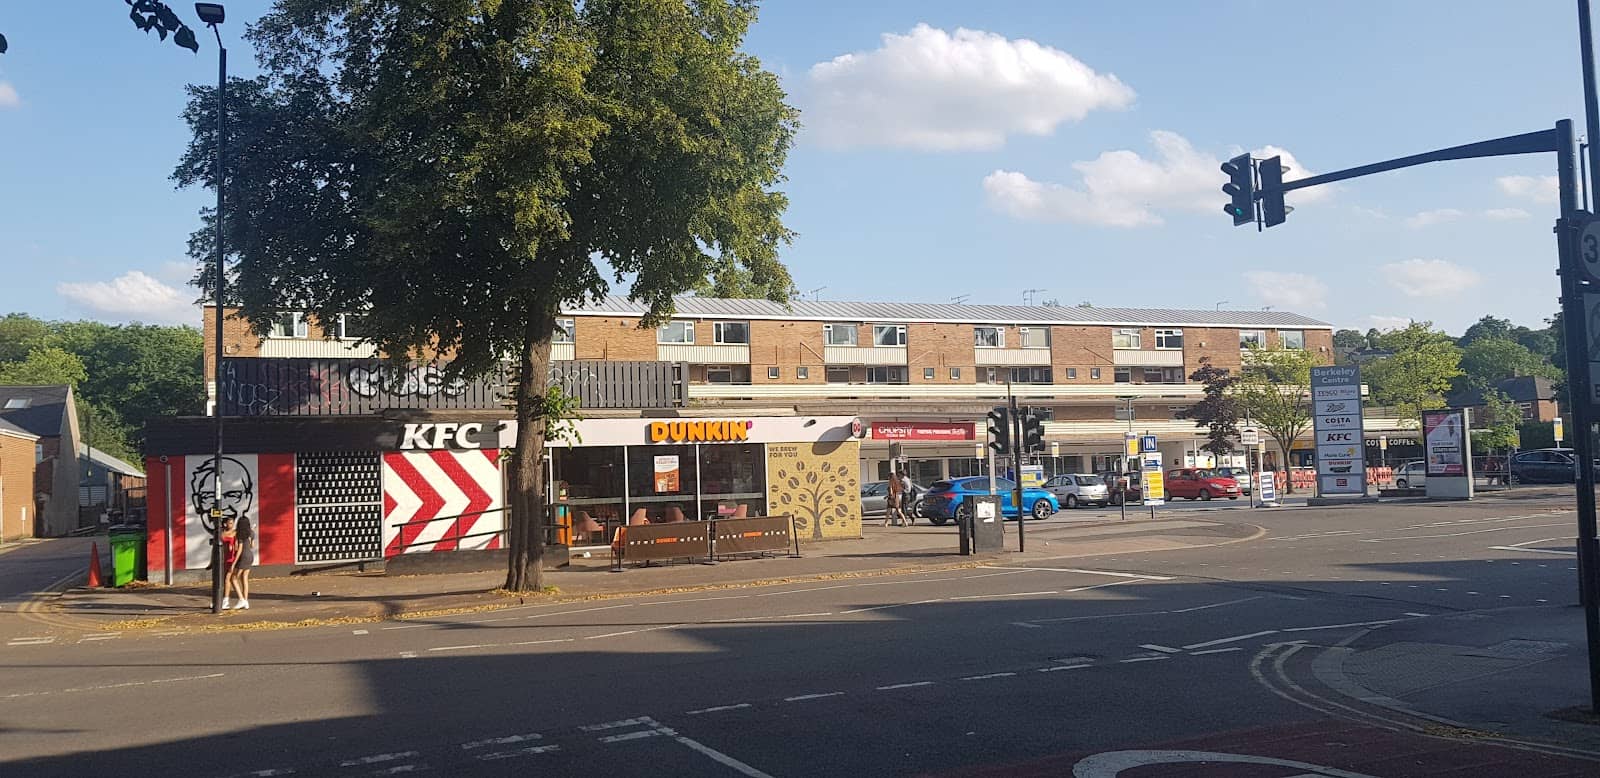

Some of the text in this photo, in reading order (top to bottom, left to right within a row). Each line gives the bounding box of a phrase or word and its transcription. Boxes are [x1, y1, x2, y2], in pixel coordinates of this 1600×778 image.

[1313, 368, 1356, 377] Berkeley
[651, 420, 753, 442] DUNKIN'
[400, 423, 483, 450] KFC
[1326, 432, 1352, 441] KFC
[1145, 437, 1155, 449] IN
[1389, 438, 1415, 446] COFFEE
